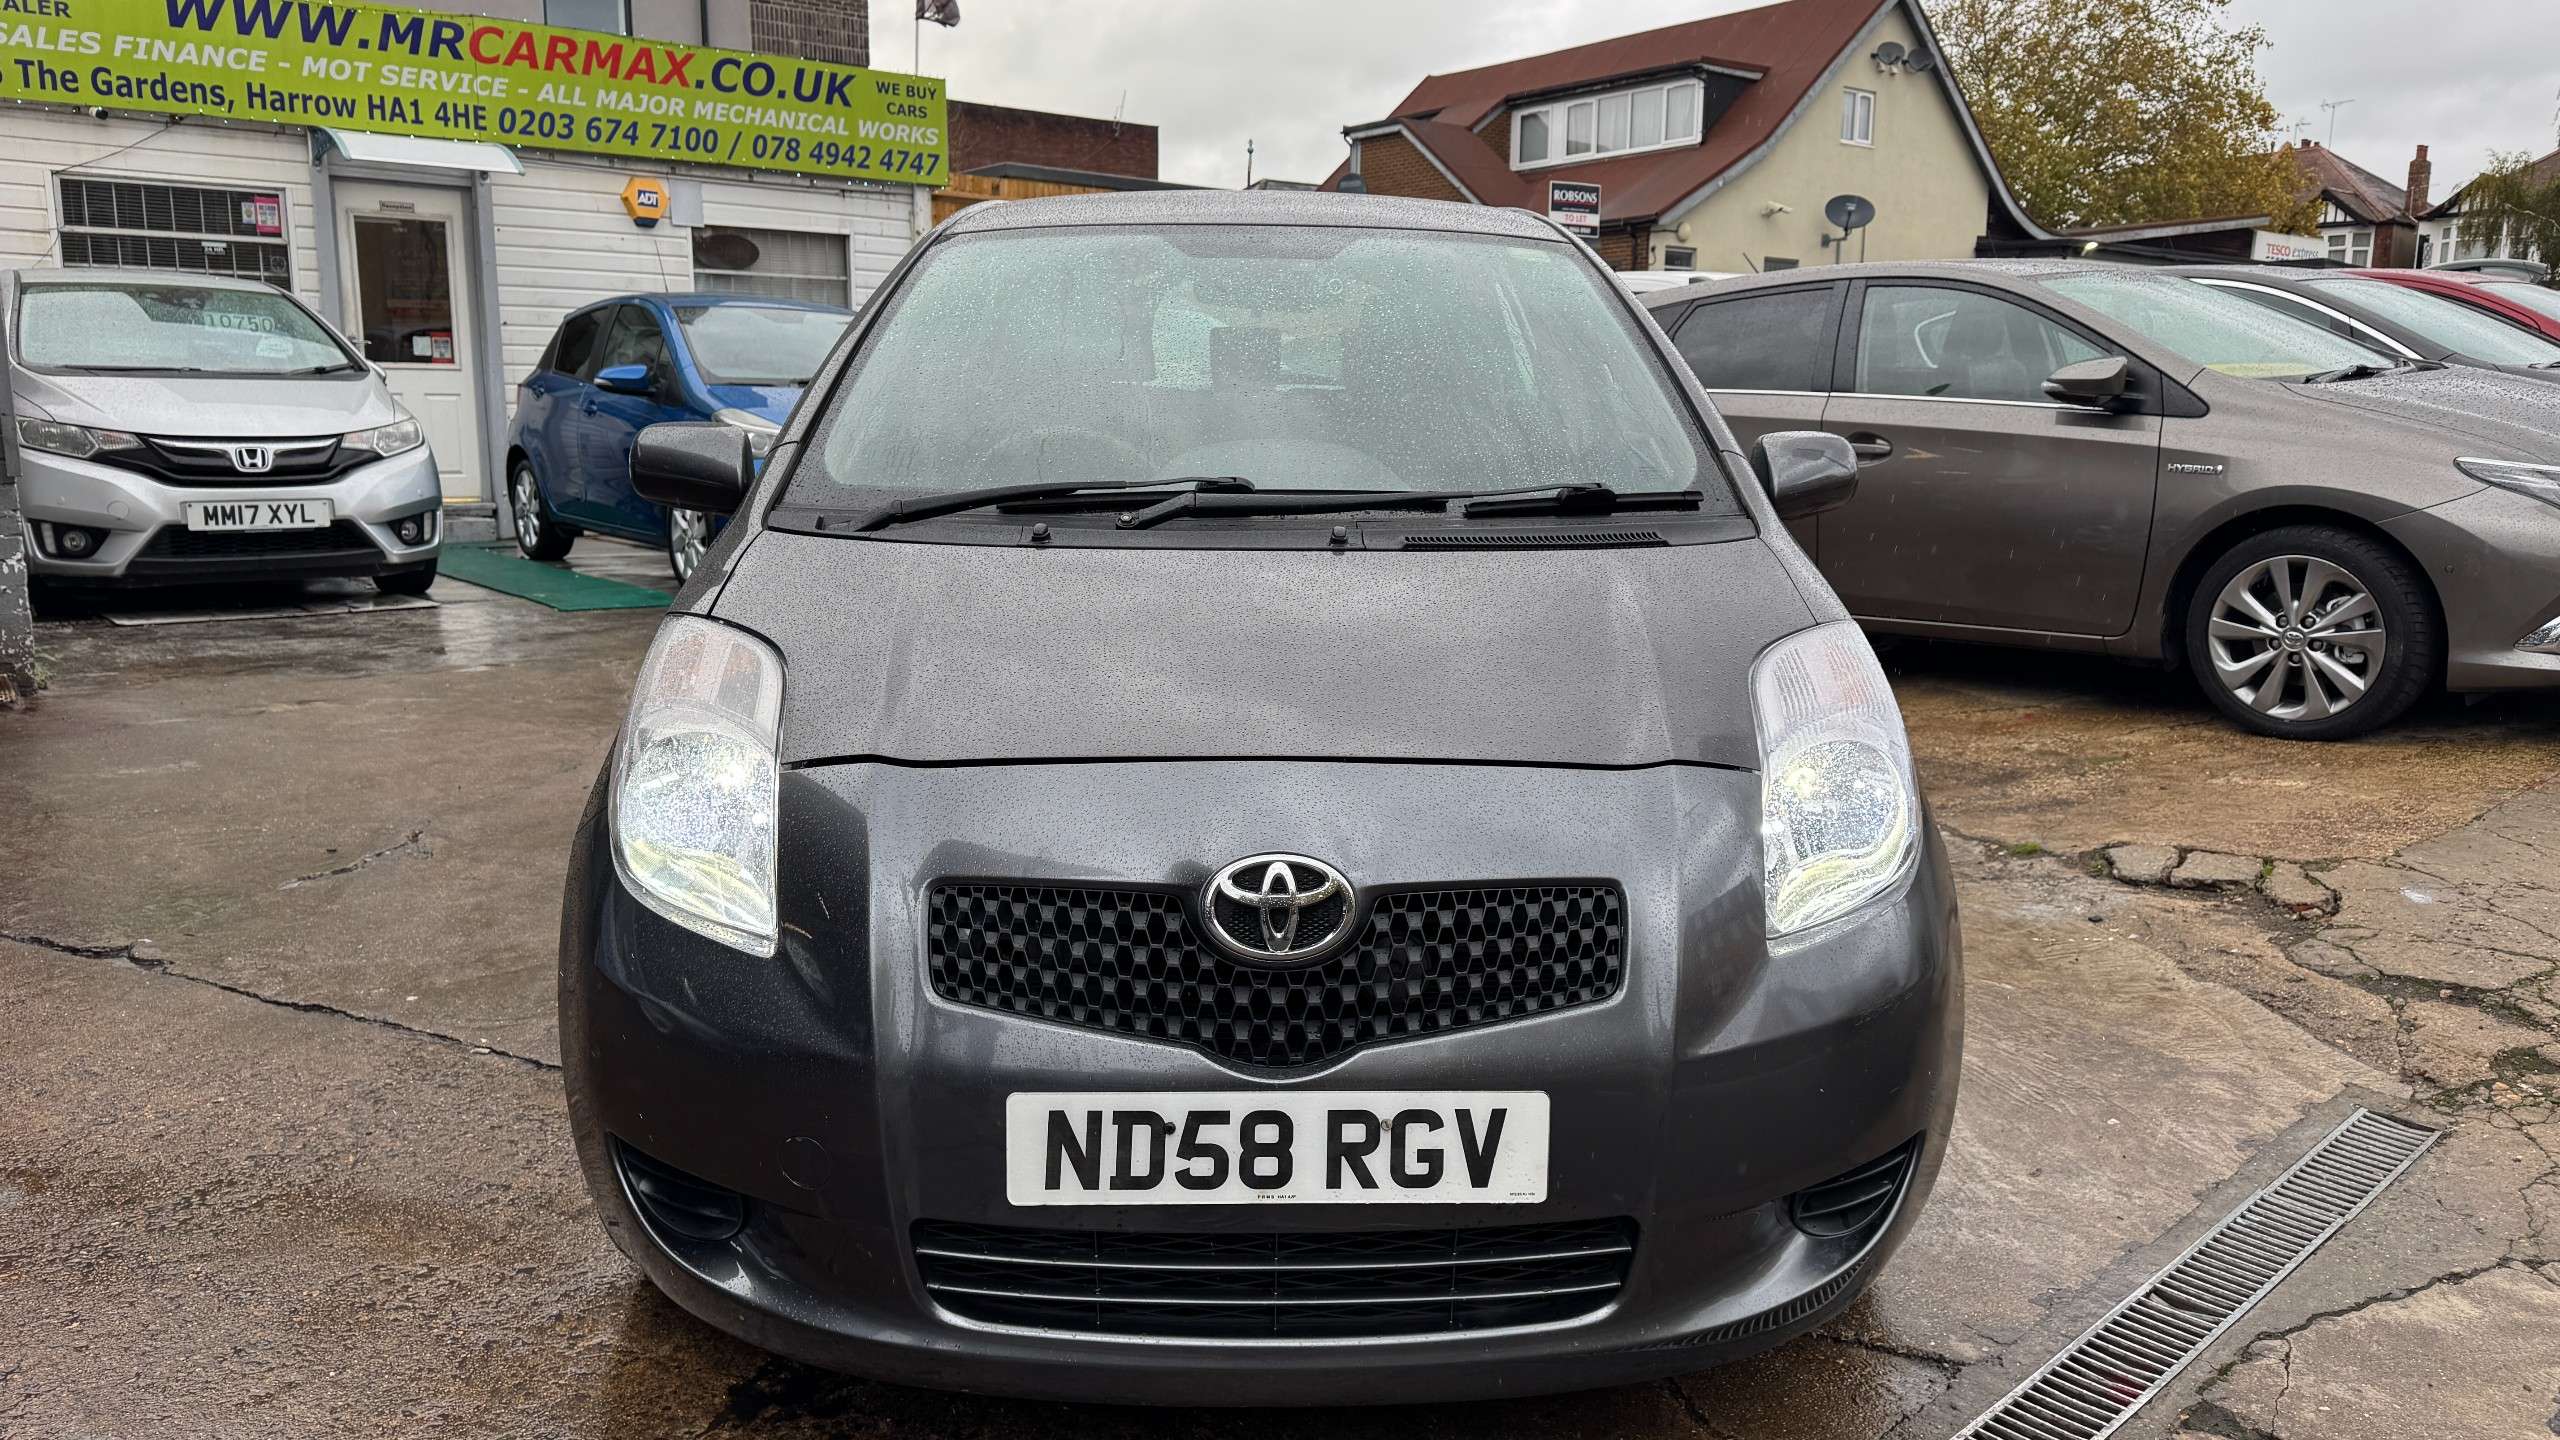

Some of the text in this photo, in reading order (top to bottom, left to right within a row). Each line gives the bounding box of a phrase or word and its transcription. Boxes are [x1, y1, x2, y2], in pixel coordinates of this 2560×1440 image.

[0, 0, 72, 18] ALER
[113, 34, 268, 73] FINANCE
[302, 55, 372, 82] MOT
[380, 64, 509, 98] SERVICE
[536, 82, 587, 107] ALL
[596, 88, 686, 118] MAJOR
[693, 100, 849, 136] MECHANICAL
[858, 119, 939, 146] WORKS
[875, 80, 937, 100] WE BUY
[14, 58, 79, 93] The
[91, 66, 234, 113] Gardens,
[246, 81, 356, 119] Harrow
[367, 94, 424, 125] HA1
[434, 101, 488, 131] 4HE
[498, 107, 575, 140] 0203
[586, 116, 639, 146] 674
[650, 123, 718, 154] 7100
[752, 133, 800, 162] 078
[809, 141, 871, 170] 4942
[879, 149, 940, 177] 4747
[886, 102, 928, 119] CARS
[638, 191, 657, 206] ADT
[1553, 189, 1598, 204] ROBSONS
[1564, 213, 1588, 223] TO LET
[2266, 243, 2291, 257] TESCO
[2167, 463, 2214, 474] HYBRID
[203, 503, 316, 526] MM17 XYL
[1043, 1108, 1508, 1191] ND58 RGV
